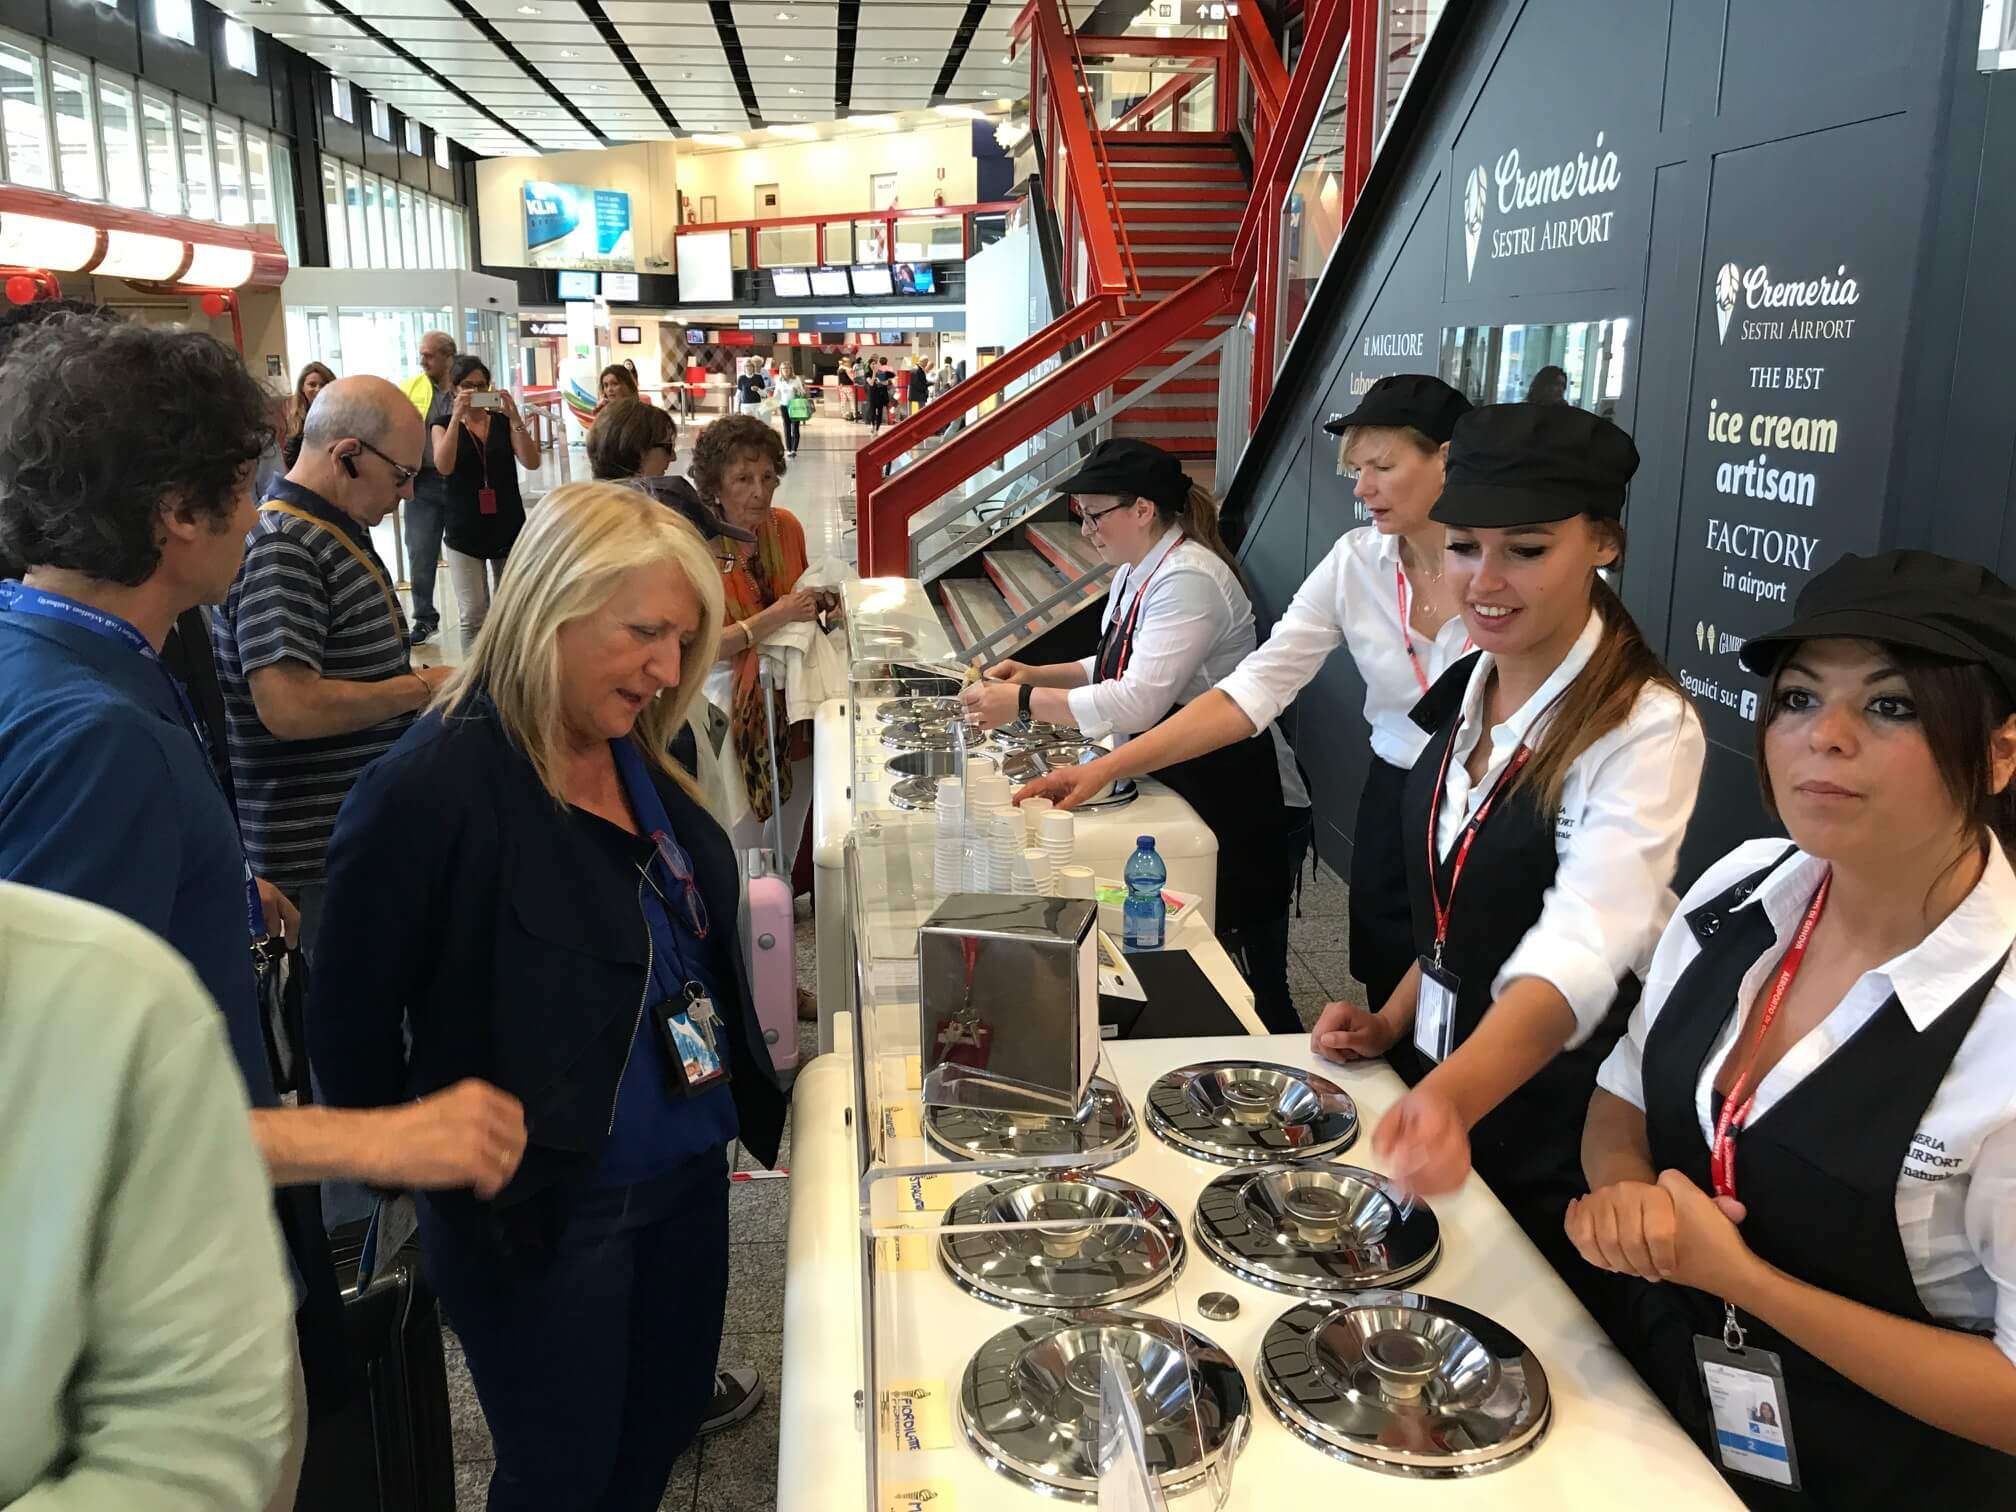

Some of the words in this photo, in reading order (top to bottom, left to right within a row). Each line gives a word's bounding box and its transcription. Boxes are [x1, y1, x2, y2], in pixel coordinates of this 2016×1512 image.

[1495, 131, 1621, 214] Cremeria
[526, 200, 558, 215] KLM
[1743, 265, 1860, 309] Cremeria
[1371, 333, 1424, 356] MIGLIORE
[1750, 366, 1781, 388] THE
[1784, 367, 1824, 390] BEST
[1708, 398, 1743, 444] ice
[1750, 414, 1838, 453] cream
[1716, 453, 1816, 506] artisan
[1705, 518, 1819, 571] FACTORY
[1722, 565, 1735, 590] in
[1738, 571, 1787, 602] airport
[1680, 669, 1717, 699] Seguici
[1720, 688, 1738, 709] su:
[1906, 1148, 1963, 1168] IRPORT
